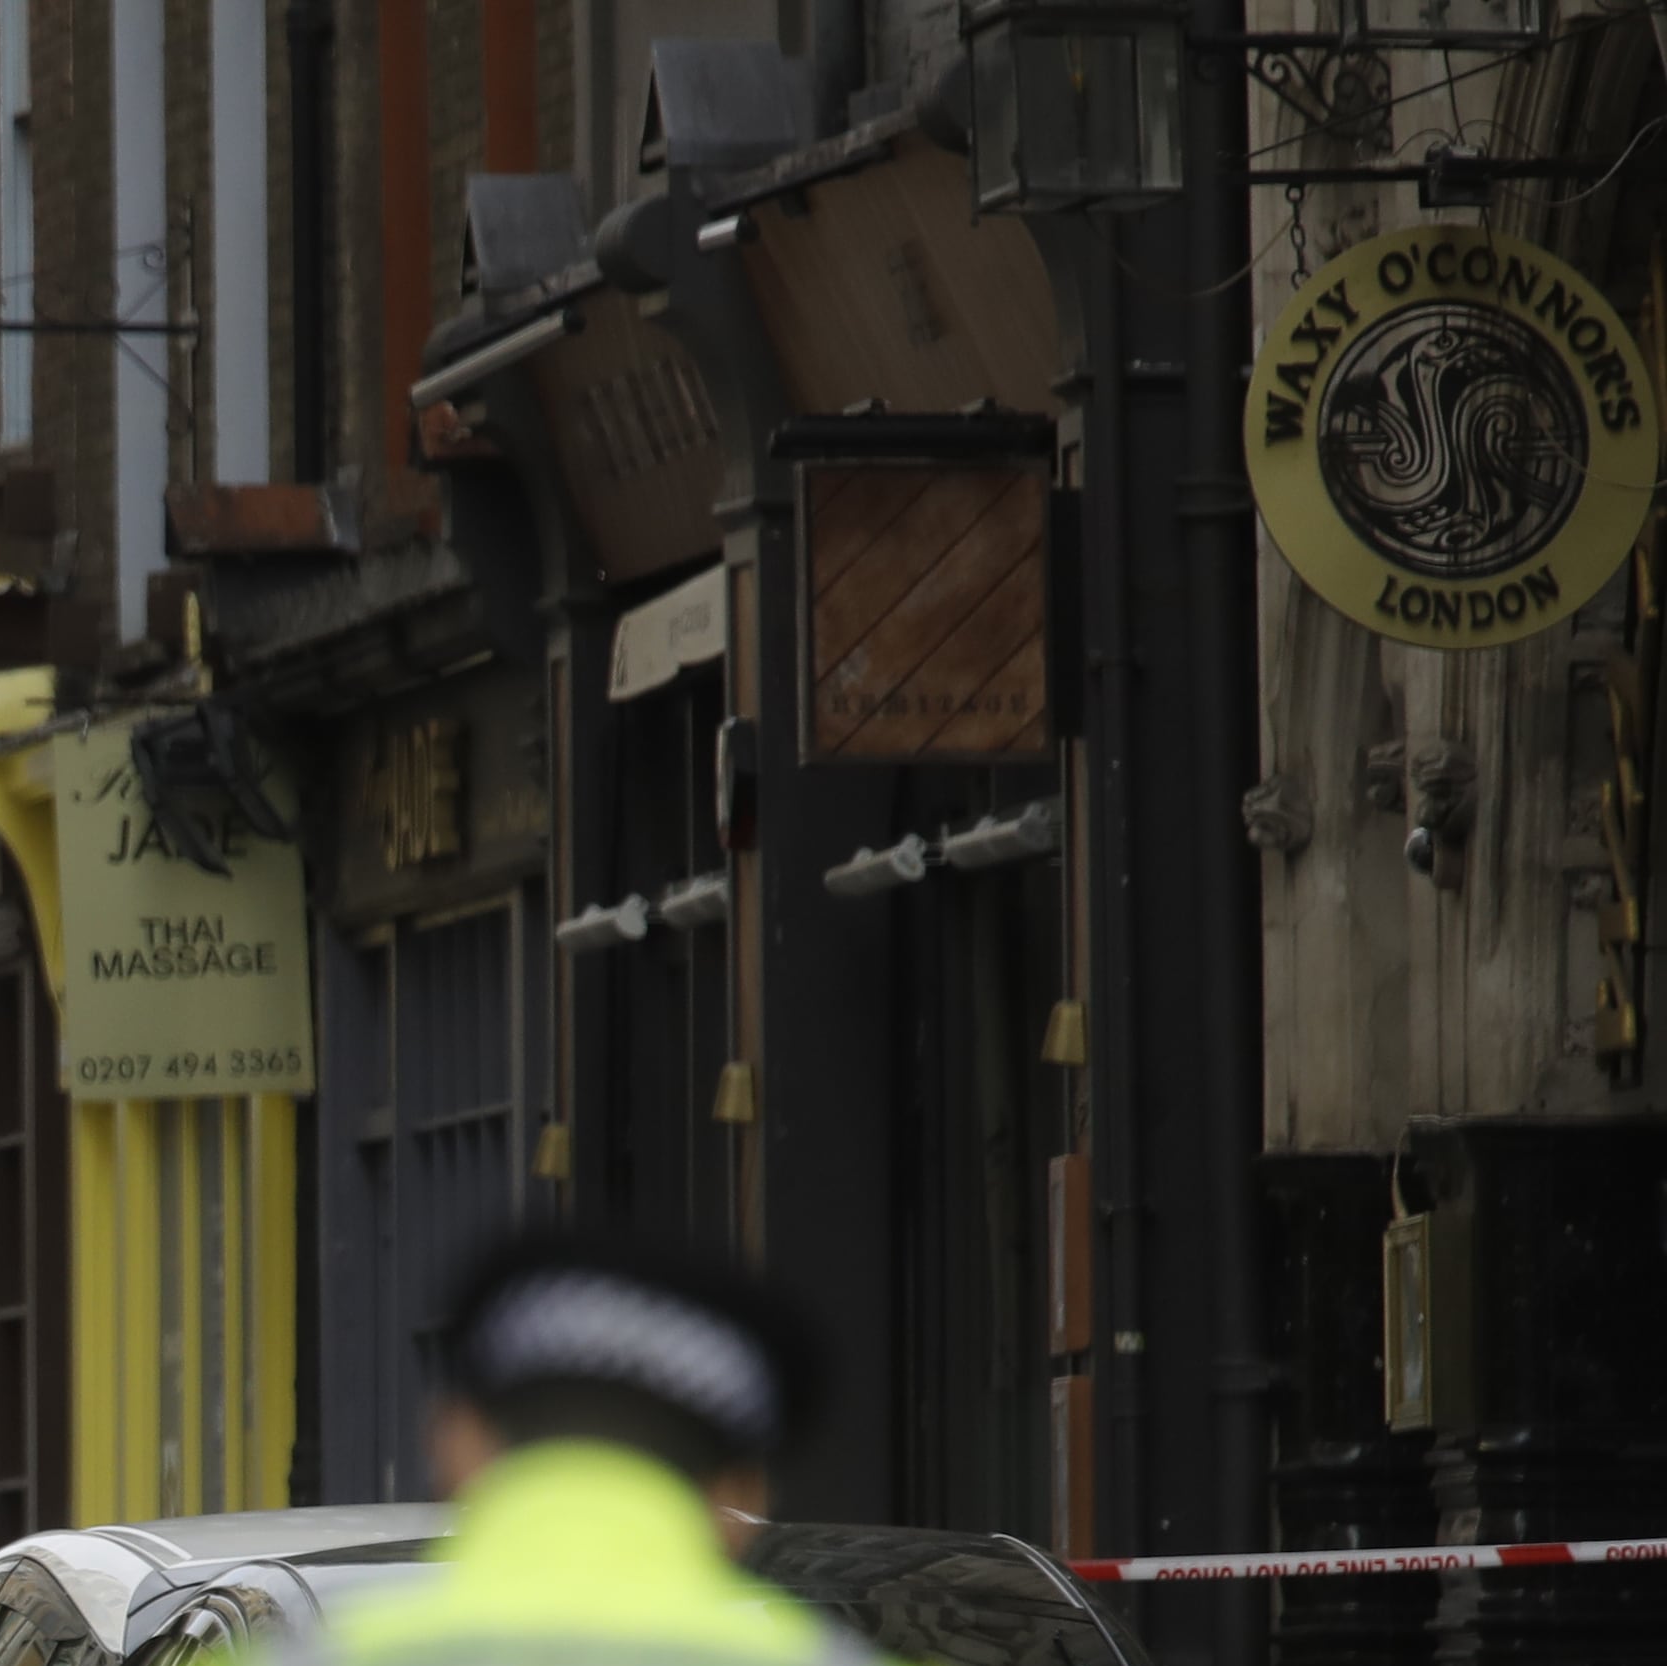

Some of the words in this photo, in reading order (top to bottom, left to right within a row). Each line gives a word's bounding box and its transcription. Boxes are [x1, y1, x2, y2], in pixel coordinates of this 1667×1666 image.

[1266, 278, 1361, 449] WAXY
[1377, 242, 1642, 436] O'CONNOR'S
[1375, 566, 1561, 630] LONDON
[108, 814, 249, 864] JAE
[139, 914, 226, 946] THAI
[92, 942, 279, 981] MASSAGE
[78, 1054, 153, 1083] 0207
[165, 1051, 219, 1079] 494
[229, 1046, 303, 1077] 3365
